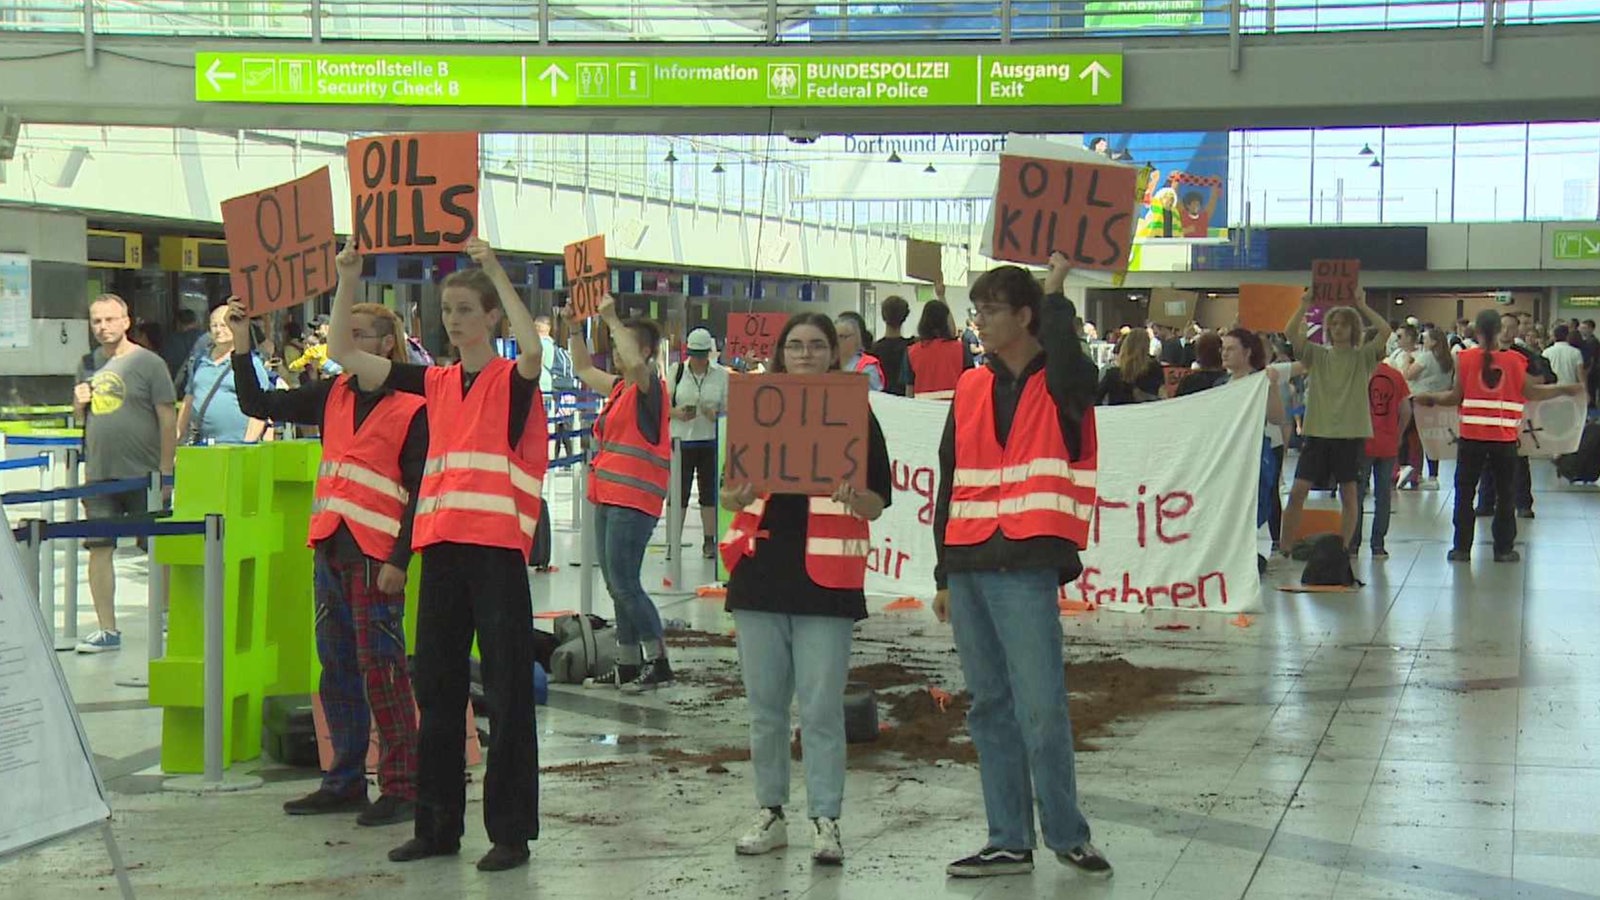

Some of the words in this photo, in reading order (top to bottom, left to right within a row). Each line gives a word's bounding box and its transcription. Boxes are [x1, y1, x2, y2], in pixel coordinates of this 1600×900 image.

[316, 59, 433, 77] Kontrollstelle
[437, 61, 449, 77] B
[653, 64, 759, 81] Information
[806, 62, 949, 79] BUNDESPOLIZEI
[989, 61, 1070, 83] Ausgang
[316, 80, 388, 98] Security
[392, 80, 444, 96] Check
[448, 81, 460, 96] B
[806, 81, 871, 98] Federal
[876, 81, 929, 98] Police
[989, 81, 1024, 98] Exit
[844, 133, 936, 154] Dortmund
[942, 133, 1007, 156] Airport
[362, 139, 437, 188] OIL
[1018, 161, 1114, 208] OIL
[256, 184, 314, 254] ÖL
[355, 184, 475, 250] KILLS
[997, 202, 1130, 265] KILLS
[239, 240, 333, 311] TÖTET
[574, 242, 593, 277] ÖL
[1317, 260, 1351, 278] OIL
[1311, 281, 1354, 301] KILLS
[744, 314, 771, 338] ÖL
[753, 384, 848, 428] OIL
[729, 437, 860, 482] KILLS
[891, 459, 935, 525] ug
[1093, 484, 1194, 548] rie
[866, 538, 910, 579] air
